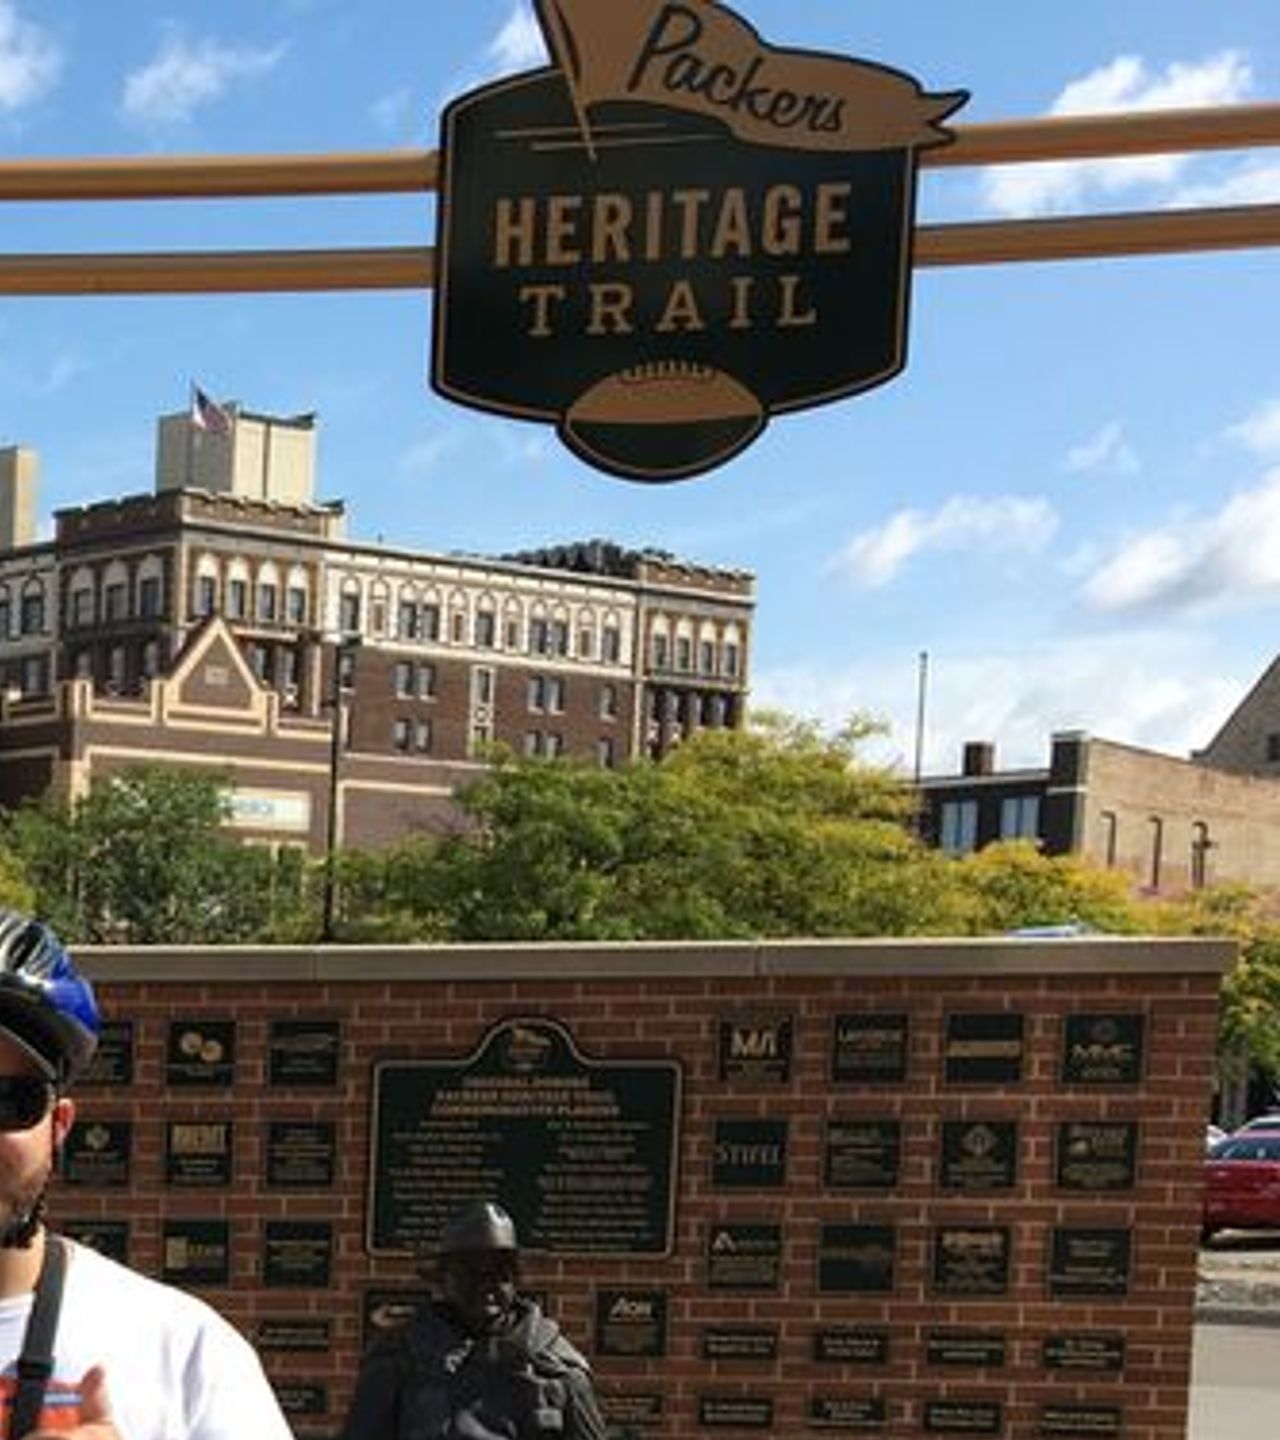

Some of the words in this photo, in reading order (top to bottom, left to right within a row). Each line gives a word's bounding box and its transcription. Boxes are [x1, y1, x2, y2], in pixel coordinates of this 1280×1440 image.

[628, 4, 843, 133] Packers
[495, 183, 851, 267] HERITAGE
[520, 276, 817, 335] TRAIL
